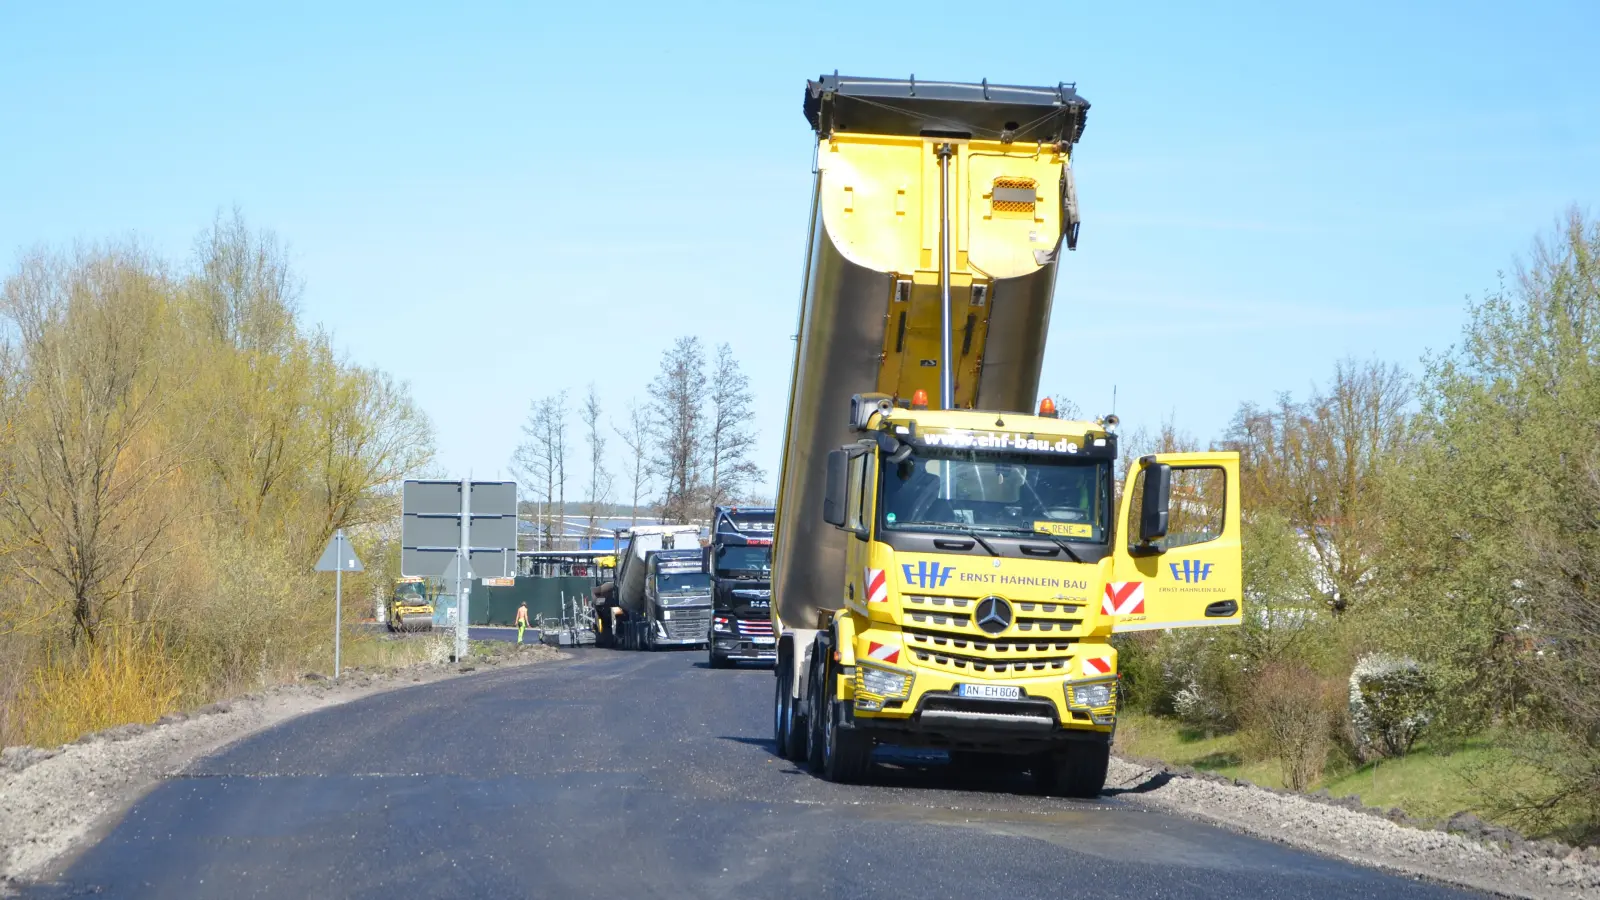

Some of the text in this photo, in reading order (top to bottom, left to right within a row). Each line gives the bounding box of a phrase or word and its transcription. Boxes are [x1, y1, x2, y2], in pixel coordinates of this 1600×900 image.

[1052, 524, 1074, 535] RENE
[960, 572, 997, 583] ERNST
[1063, 579, 1088, 590] BAU
[966, 685, 979, 696] AN
